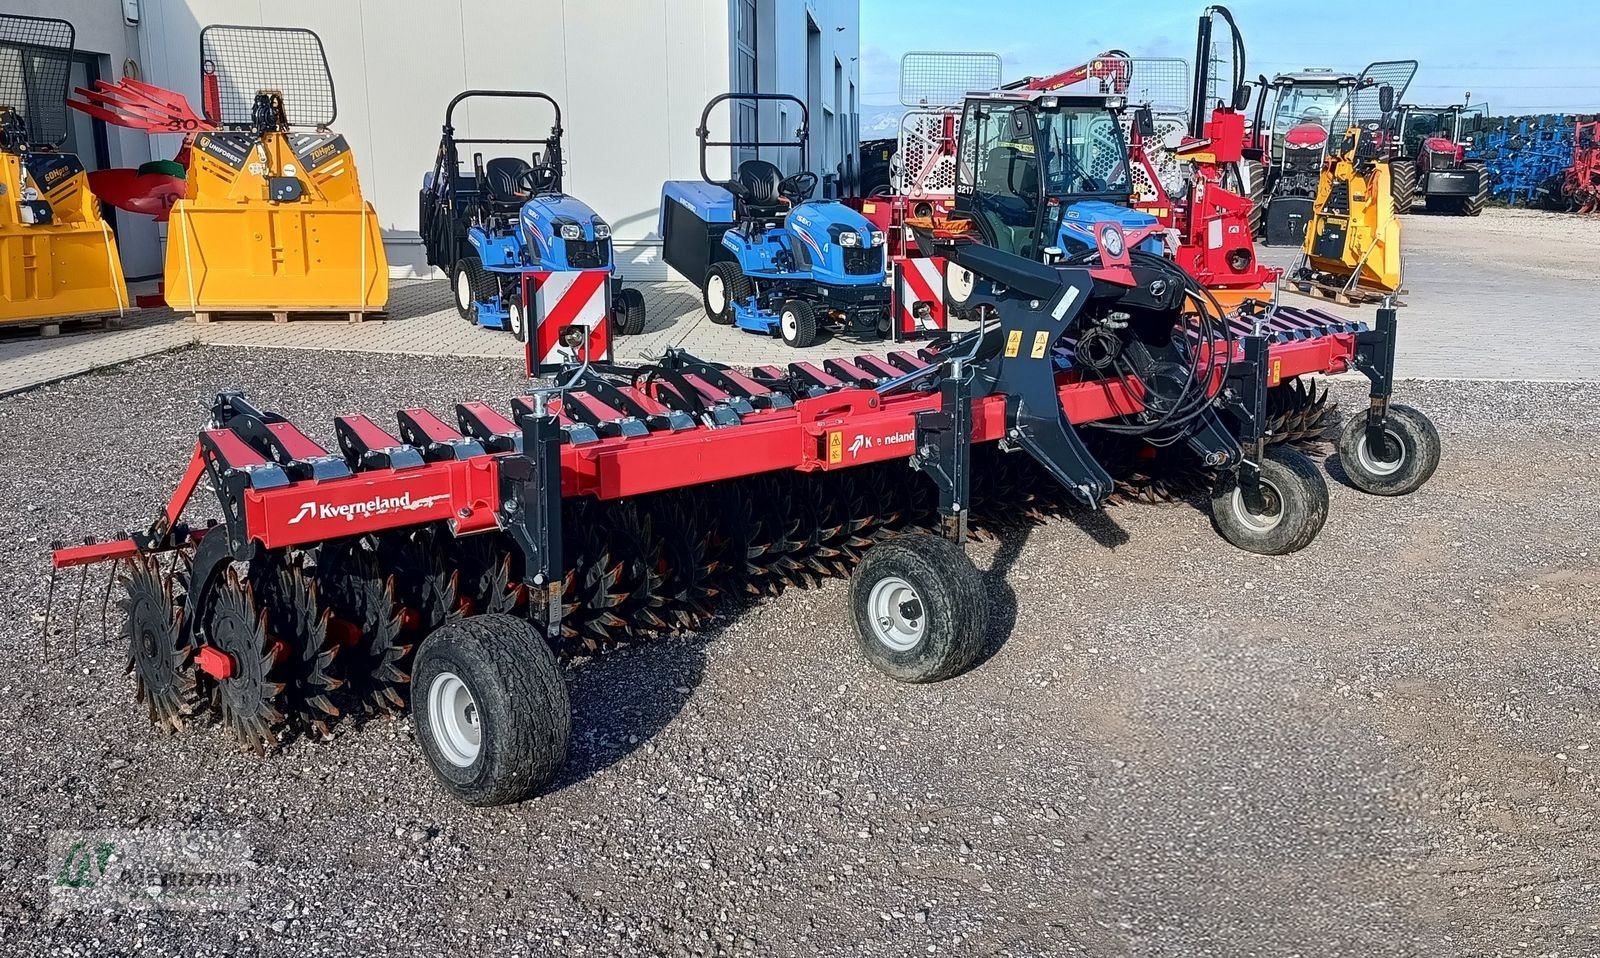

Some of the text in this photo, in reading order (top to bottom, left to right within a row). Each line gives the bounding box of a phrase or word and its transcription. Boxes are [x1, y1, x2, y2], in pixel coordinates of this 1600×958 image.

[168, 119, 198, 131] 30
[209, 142, 242, 164] UNIFOREST
[309, 143, 336, 161] 70Hpro
[44, 165, 70, 182] 60Hpro
[957, 185, 974, 194] 3217
[865, 429, 915, 449] Keneland
[320, 491, 410, 519] Kverneland
